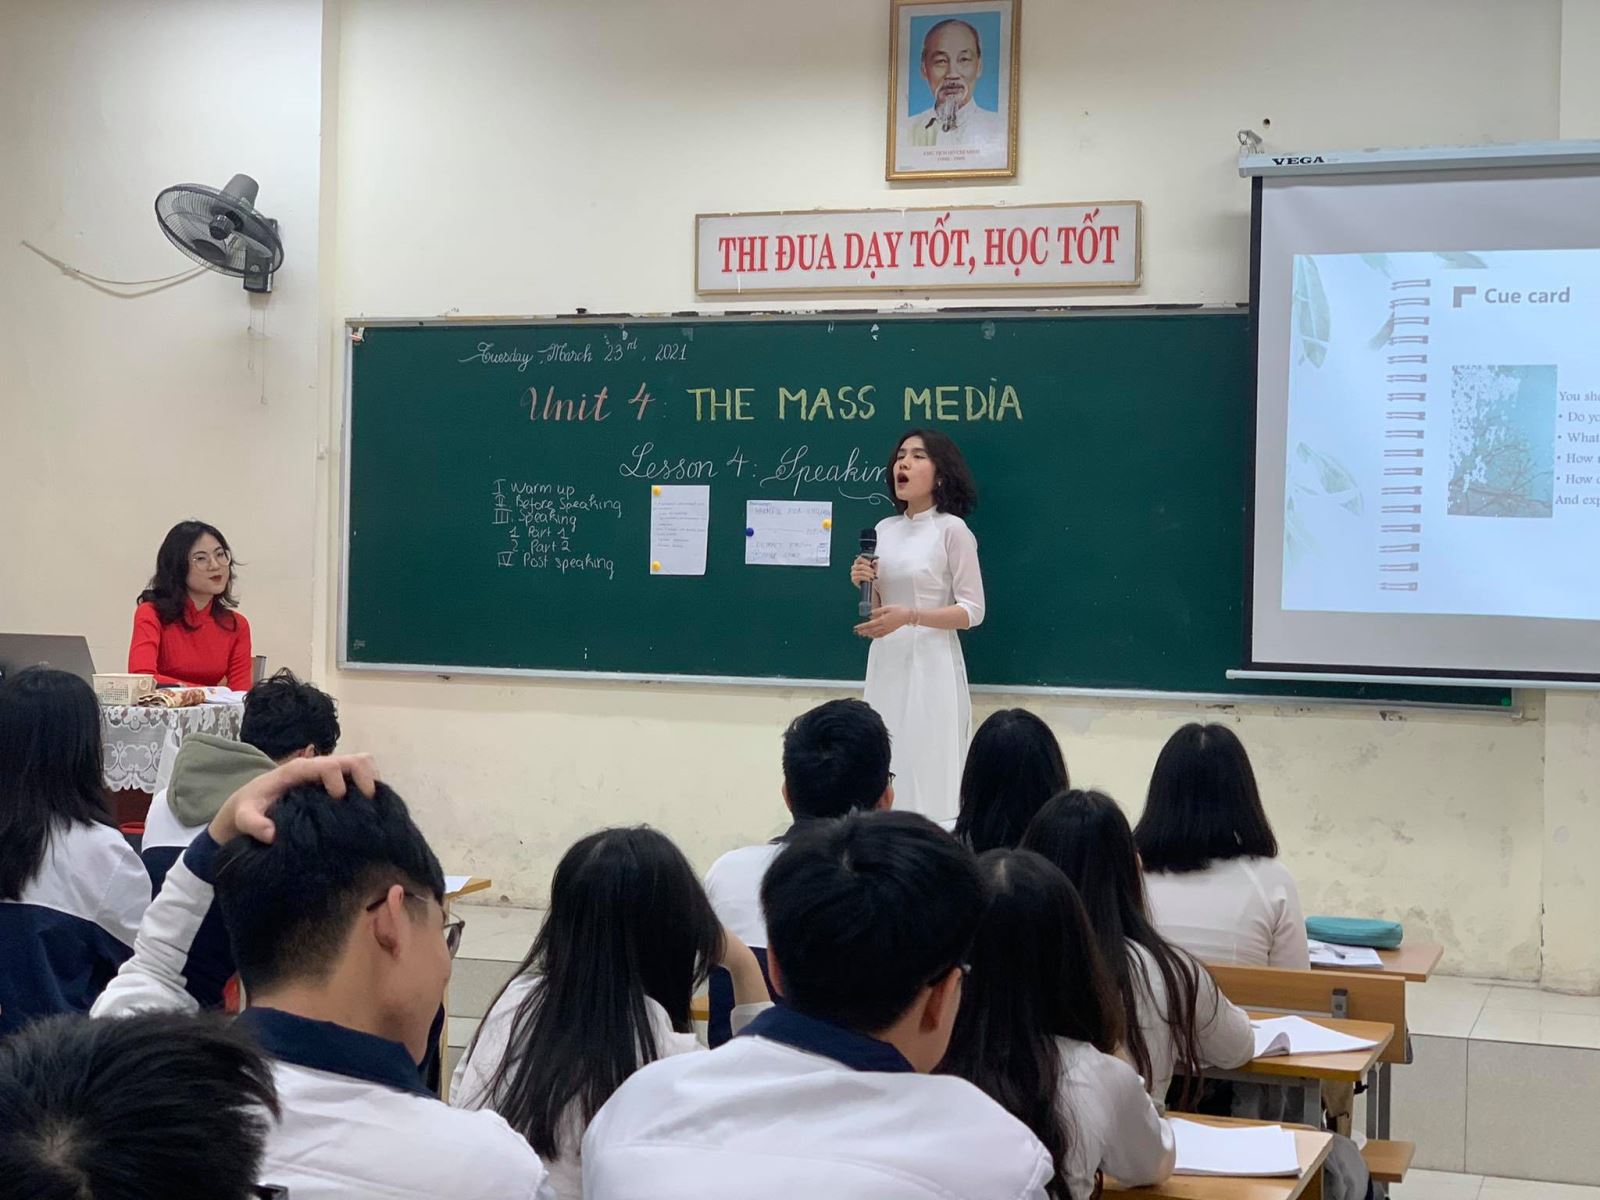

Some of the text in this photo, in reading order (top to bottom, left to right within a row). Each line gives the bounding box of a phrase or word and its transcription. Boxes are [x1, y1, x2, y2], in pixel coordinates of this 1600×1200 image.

[1271, 156, 1325, 166] VEGA
[718, 208, 1120, 279] THI ĐUA DẠY TỐT, HỌC TỐT
[1484, 286, 1571, 304] Cue card
[537, 343, 593, 363] March
[655, 343, 687, 361] 2021
[521, 385, 612, 421] Unit
[686, 387, 755, 421] THE
[778, 385, 877, 421] MASS
[1559, 391, 1580, 402] You
[1568, 411, 1585, 422] Do
[1566, 453, 1594, 464] How
[620, 442, 718, 480] Lesson
[760, 445, 888, 498] Speakin
[1565, 474, 1593, 484] How
[557, 485, 575, 499] up
[516, 494, 554, 514] Before
[1555, 495, 1579, 505] And
[528, 525, 551, 538] Part
[557, 527, 570, 540] 1
[530, 540, 556, 555] Part
[561, 540, 571, 552] 2
[523, 552, 549, 568] Post
